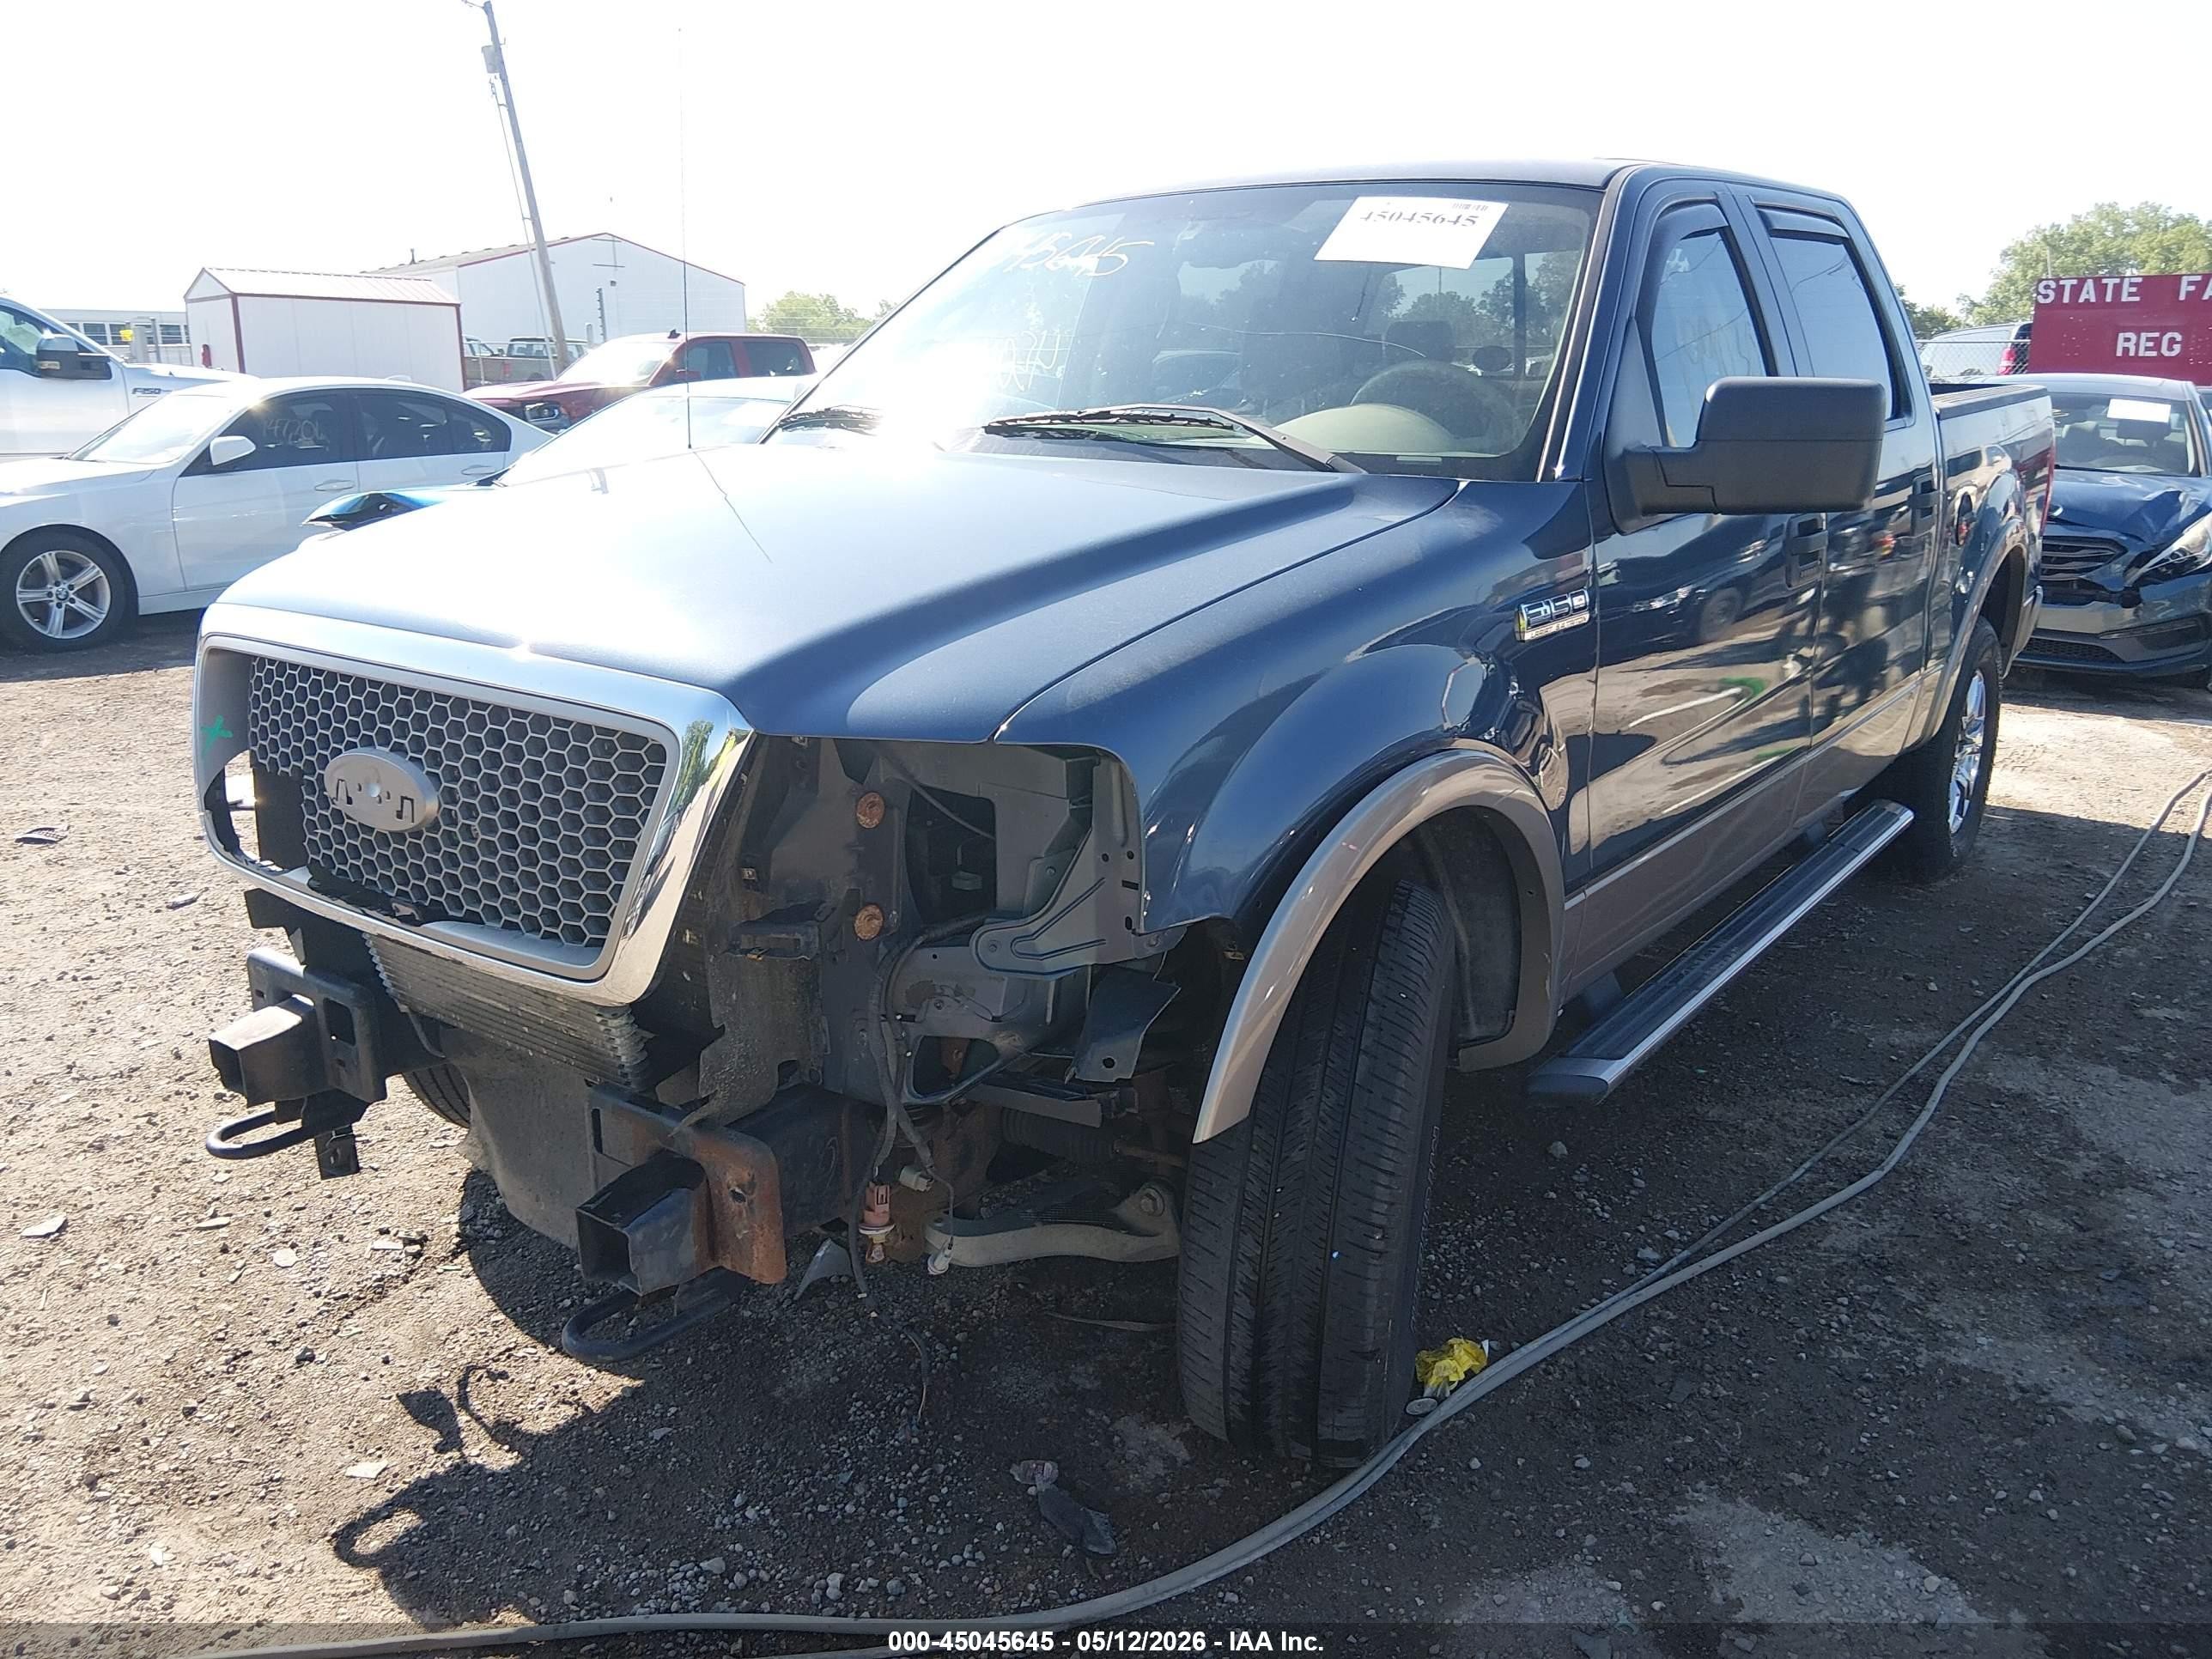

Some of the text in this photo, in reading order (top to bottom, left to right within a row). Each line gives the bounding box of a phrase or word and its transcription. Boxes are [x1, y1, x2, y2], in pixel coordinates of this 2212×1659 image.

[1359, 210, 1480, 228] 45045645
[2037, 279, 2142, 304] STATE
[2116, 332, 2182, 357] REG
